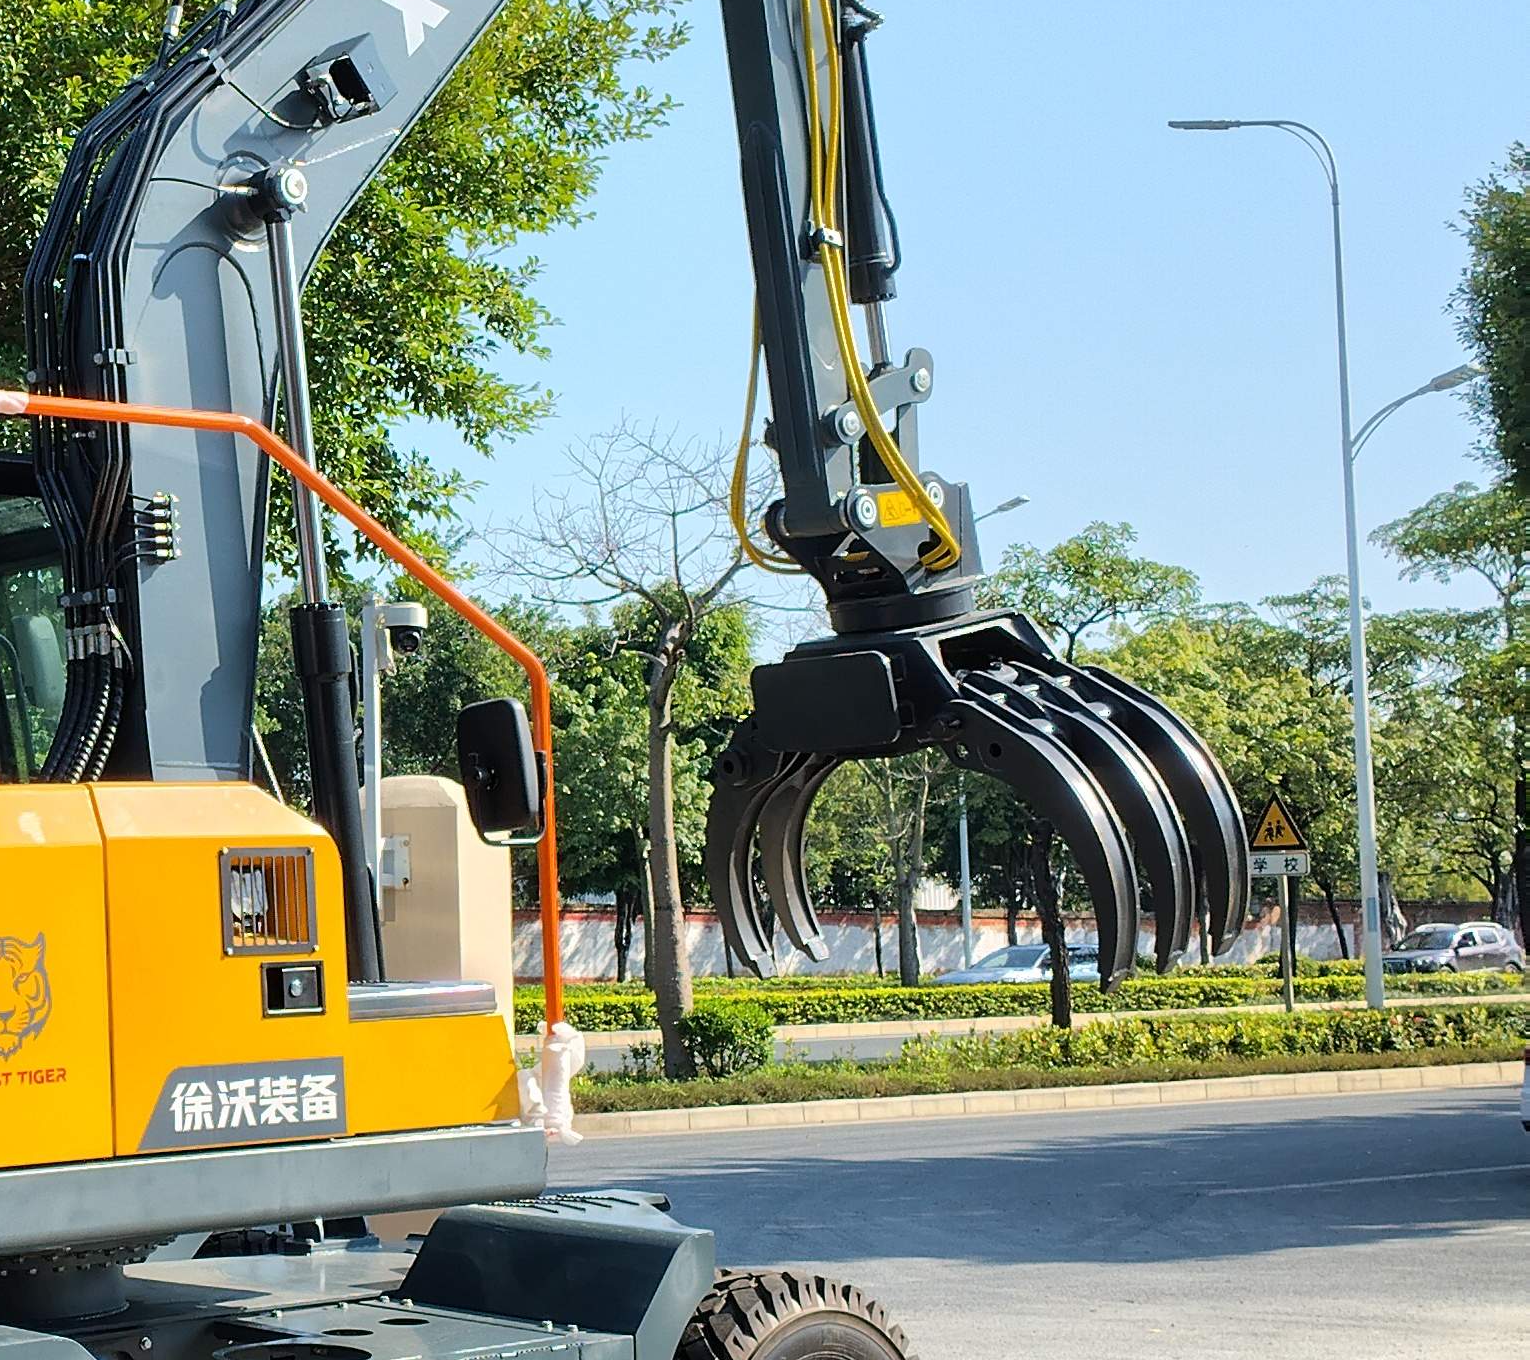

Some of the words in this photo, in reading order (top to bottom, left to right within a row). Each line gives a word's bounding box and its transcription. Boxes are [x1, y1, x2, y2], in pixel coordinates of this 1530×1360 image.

[1253, 856, 1299, 872] 学校
[17, 1067, 67, 1085] TIGER
[169, 1074, 338, 1132] 徐沃装备
